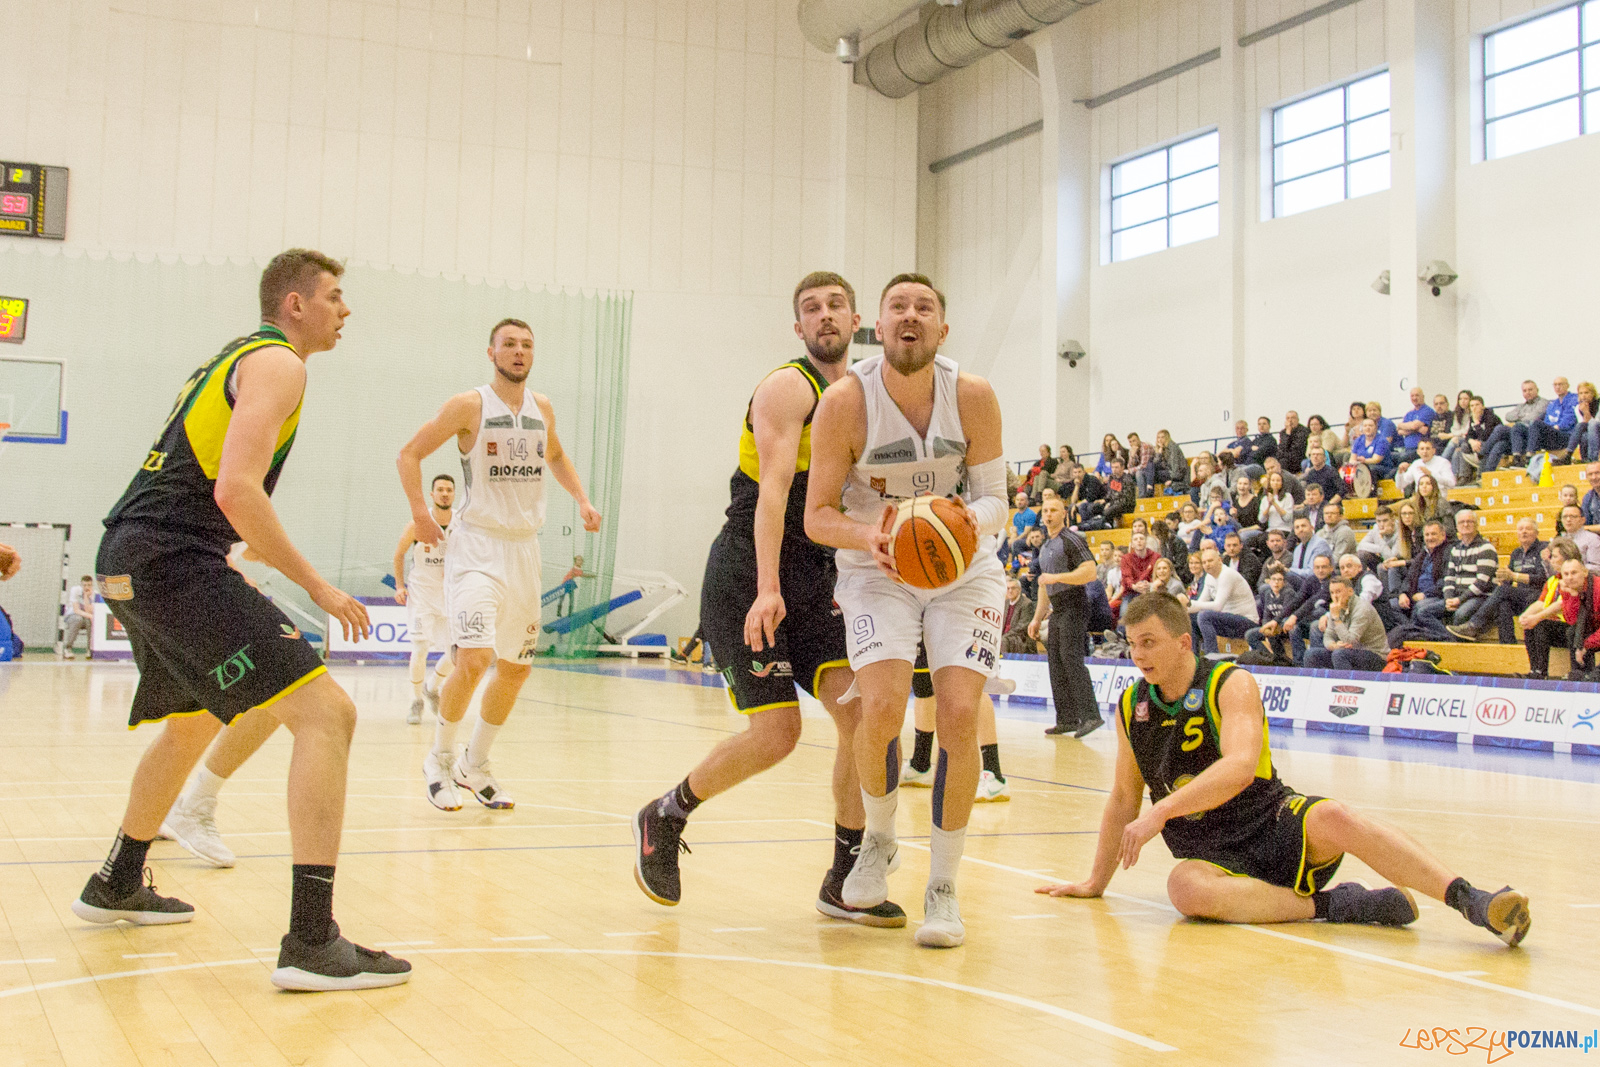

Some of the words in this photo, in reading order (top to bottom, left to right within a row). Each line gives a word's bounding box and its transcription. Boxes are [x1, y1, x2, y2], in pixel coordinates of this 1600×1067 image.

[13, 168, 23, 183] 2
[2, 195, 28, 213] 53
[507, 438, 528, 461] 14
[490, 465, 541, 476] BIOFARM
[913, 471, 935, 498] 9
[562, 526, 571, 536] D
[458, 611, 484, 632] 14
[853, 614, 875, 645] 9
[1262, 685, 1292, 712] PBG
[1333, 694, 1358, 706] JOKER
[1407, 696, 1468, 718] NICKEL
[1482, 703, 1508, 720] KIA
[1524, 706, 1566, 725] DELIK
[1181, 717, 1204, 752] 5
